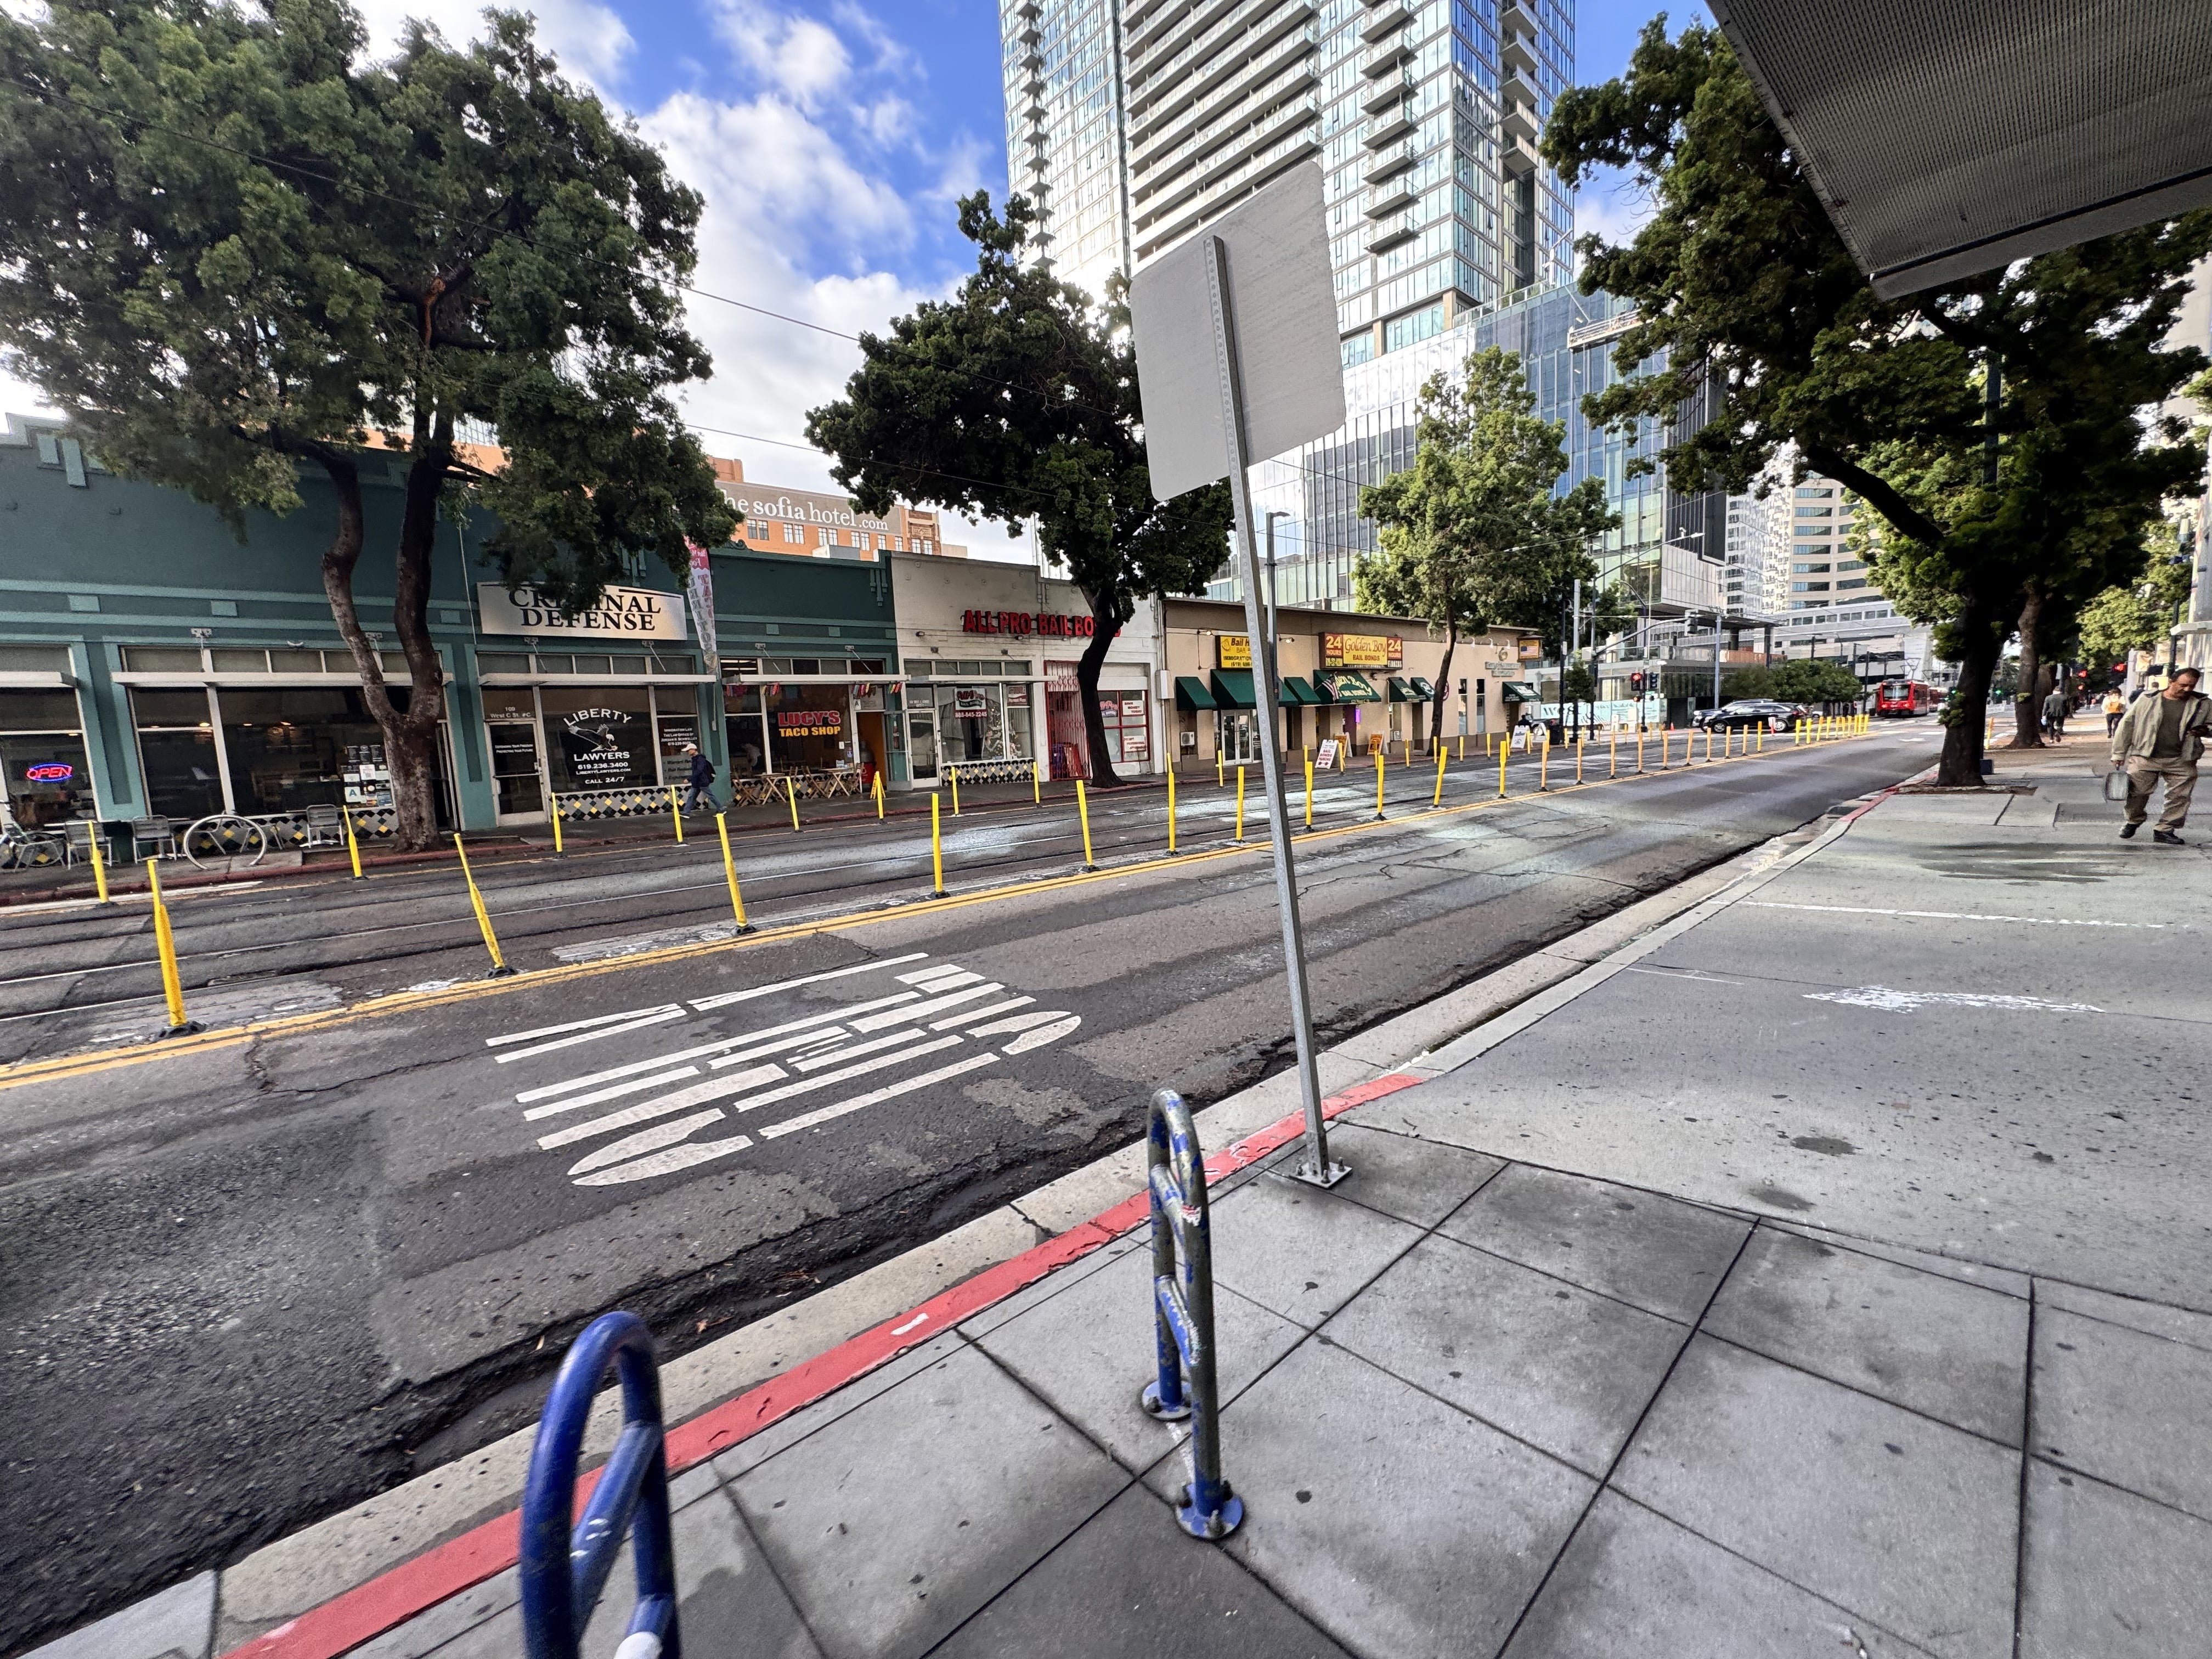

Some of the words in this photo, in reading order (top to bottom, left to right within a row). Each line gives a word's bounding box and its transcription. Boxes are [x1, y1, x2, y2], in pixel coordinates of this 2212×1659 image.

[723, 489, 749, 513] he
[752, 496, 805, 521] sofia
[808, 501, 855, 527] hotel
[520, 608, 656, 631] DEFENSE
[962, 610, 997, 633] ALL
[997, 611, 1031, 635] PRO
[1036, 614, 1072, 636] BAIL
[1231, 637, 1244, 646] Bail
[1325, 635, 1342, 649] 24
[1345, 637, 1372, 654] Golden
[1372, 639, 1386, 657] Boy
[1387, 640, 1401, 652] 24
[563, 708, 633, 726] LIBERTY
[777, 710, 841, 727] LUCY'S
[778, 727, 809, 737] TACO
[811, 726, 840, 736] SHOP
[573, 751, 630, 761] LAWYERS
[577, 761, 629, 770] 619.236.3400
[26, 766, 72, 780] OPEN
